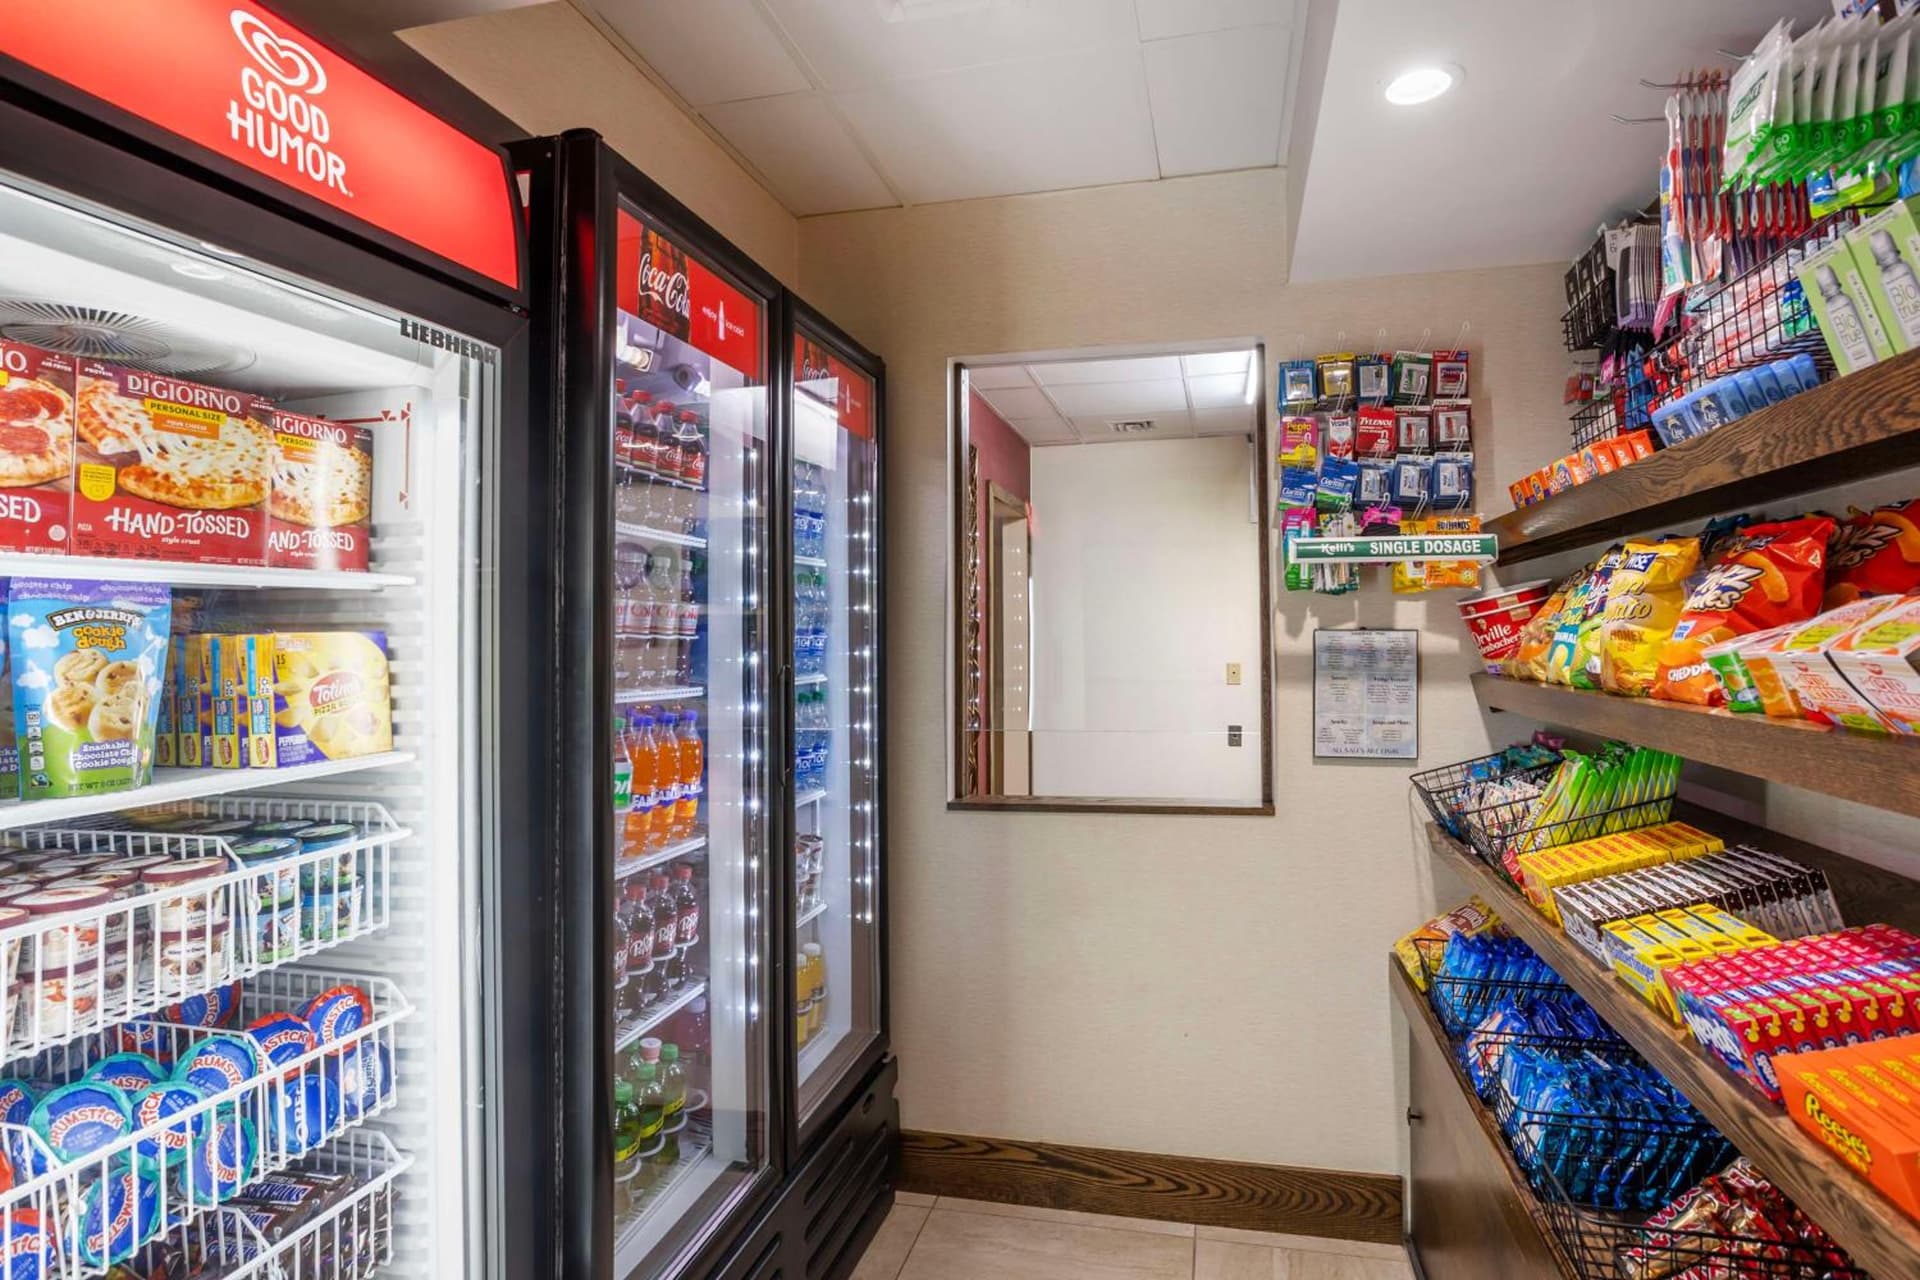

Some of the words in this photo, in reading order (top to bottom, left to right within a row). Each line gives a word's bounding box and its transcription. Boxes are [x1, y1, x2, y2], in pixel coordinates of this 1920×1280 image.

[241, 67, 330, 144] GOOD
[226, 100, 350, 193] HUMOR
[400, 317, 497, 363] LIEBHERR
[128, 375, 241, 414] DIGIORNO
[150, 402, 201, 418] PERSONAL
[203, 411, 221, 421] SIZE
[1360, 416, 1393, 427] TYLENOL
[1370, 541, 1420, 554] SINGLE
[1426, 540, 1481, 553] DOSAGE
[73, 625, 125, 638] cookie
[1472, 624, 1512, 648] Orville
[76, 636, 126, 651] dough
[276, 654, 286, 665] 15
[1668, 661, 1711, 682] CHEDDA
[74, 758, 110, 770] Cookie
